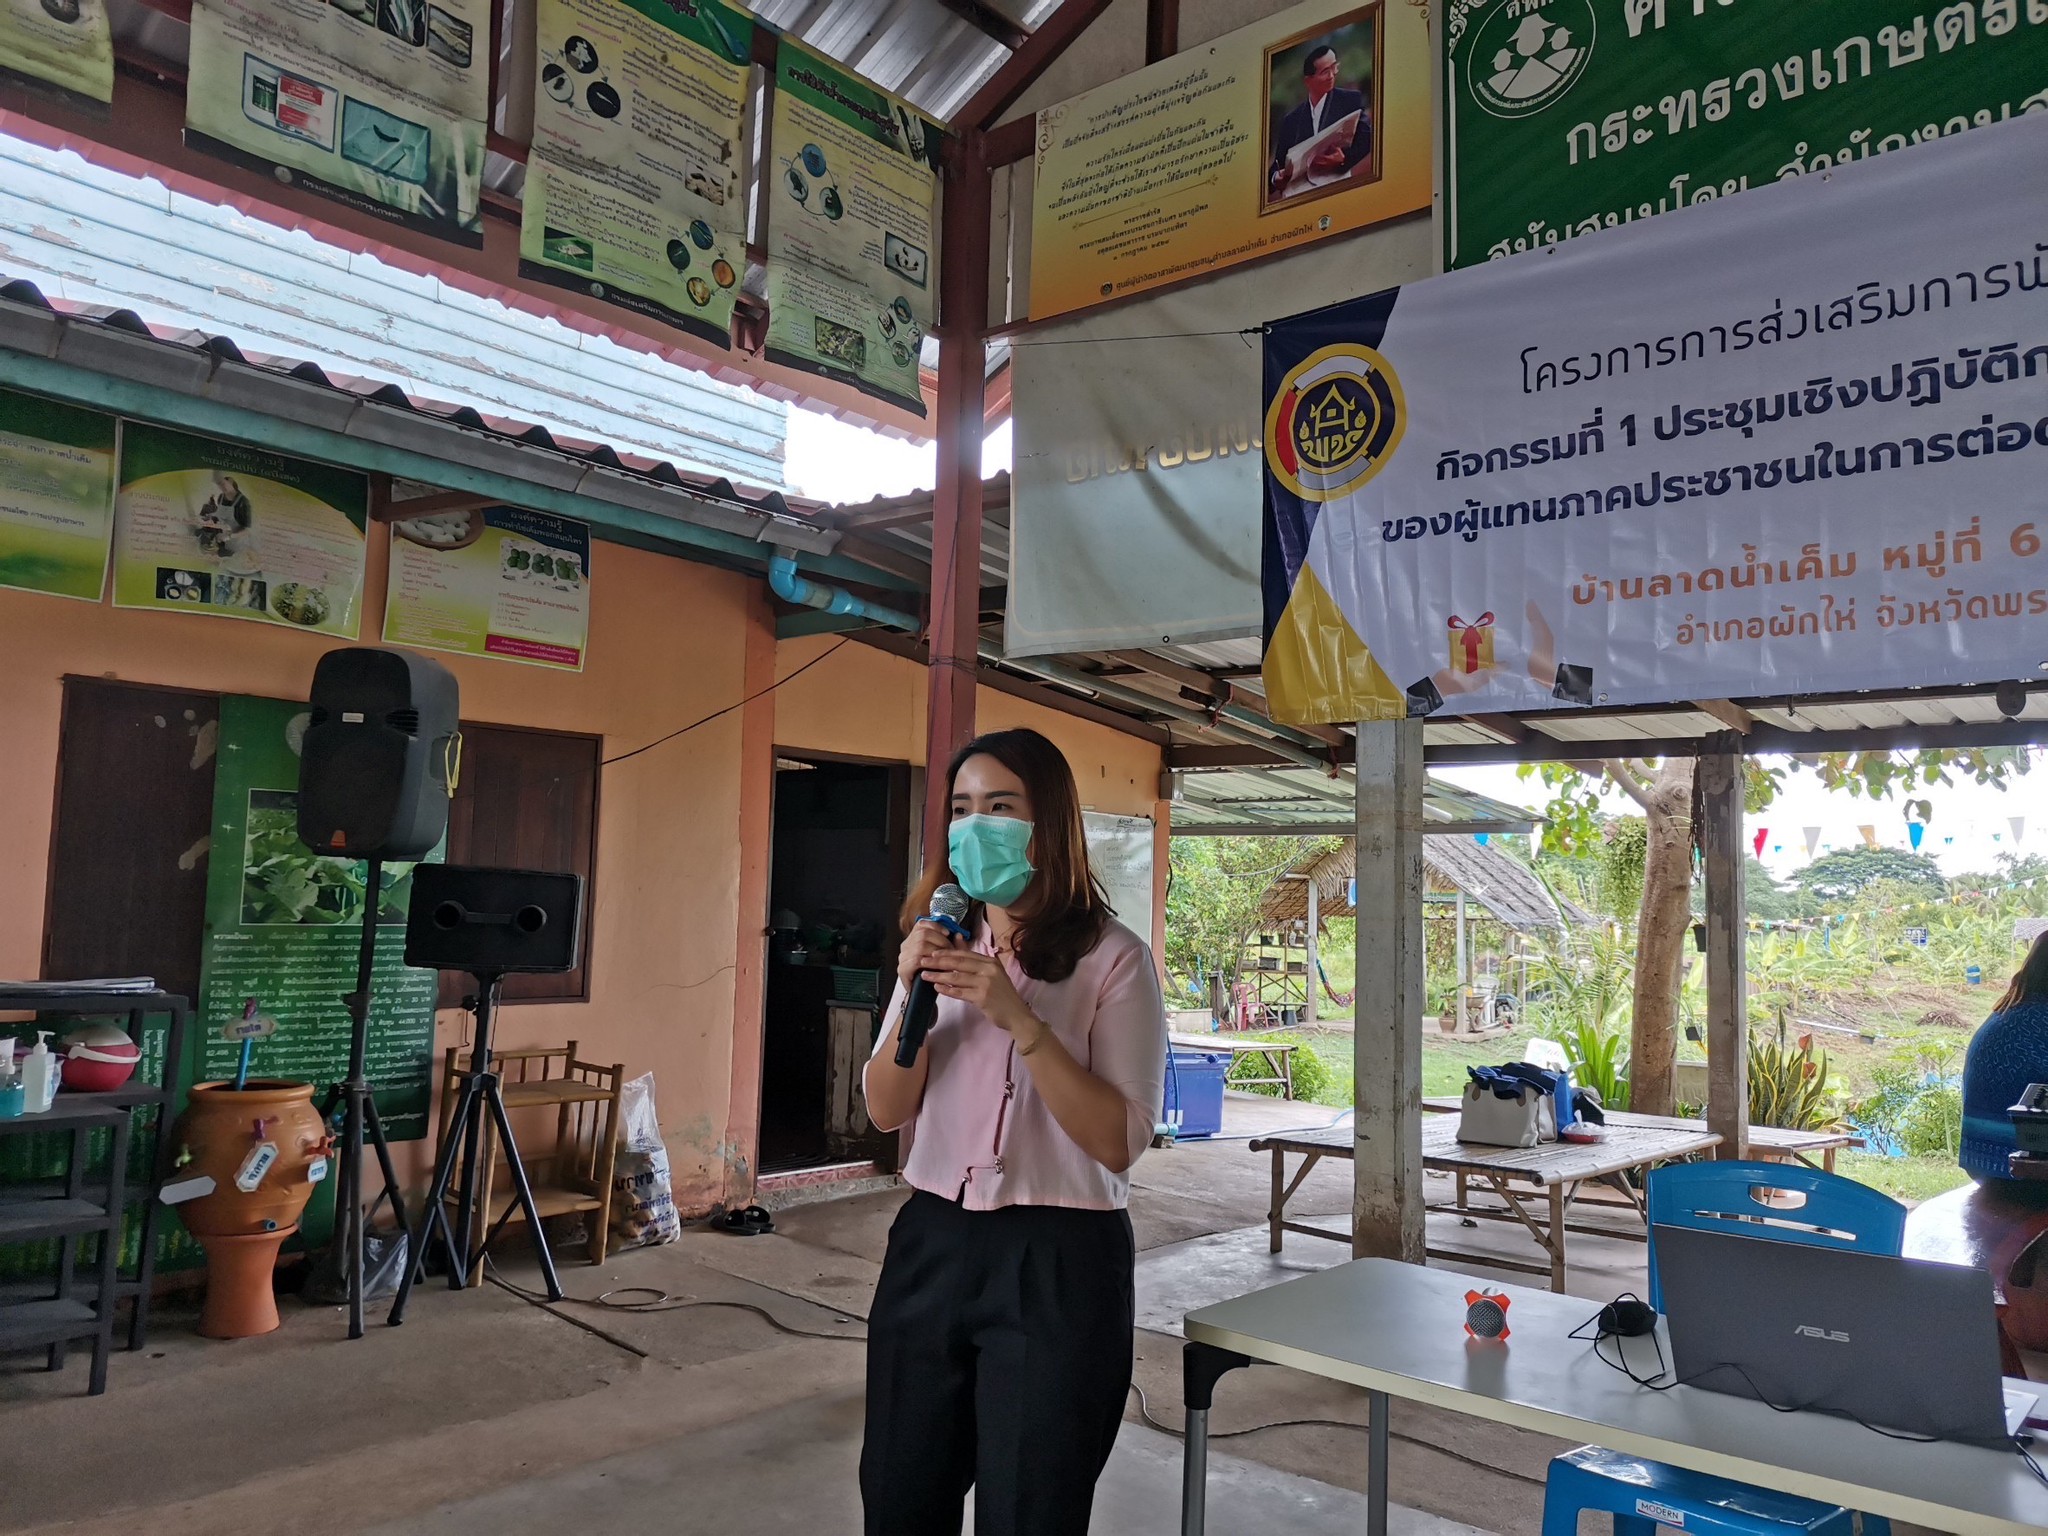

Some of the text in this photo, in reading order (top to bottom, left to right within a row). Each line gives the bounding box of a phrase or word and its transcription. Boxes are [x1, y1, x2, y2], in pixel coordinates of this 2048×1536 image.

[1436, 406, 1604, 480] กิจกรรมที่
[1619, 414, 1637, 447] 1
[1572, 516, 2041, 605] บ้านลาดน้ำเค็ม หมู่ที่ 6
[1676, 594, 1857, 646] อำเภอผักไห่
[1794, 1324, 1851, 1343] ASUS
[1641, 1502, 1679, 1519] MODERN
